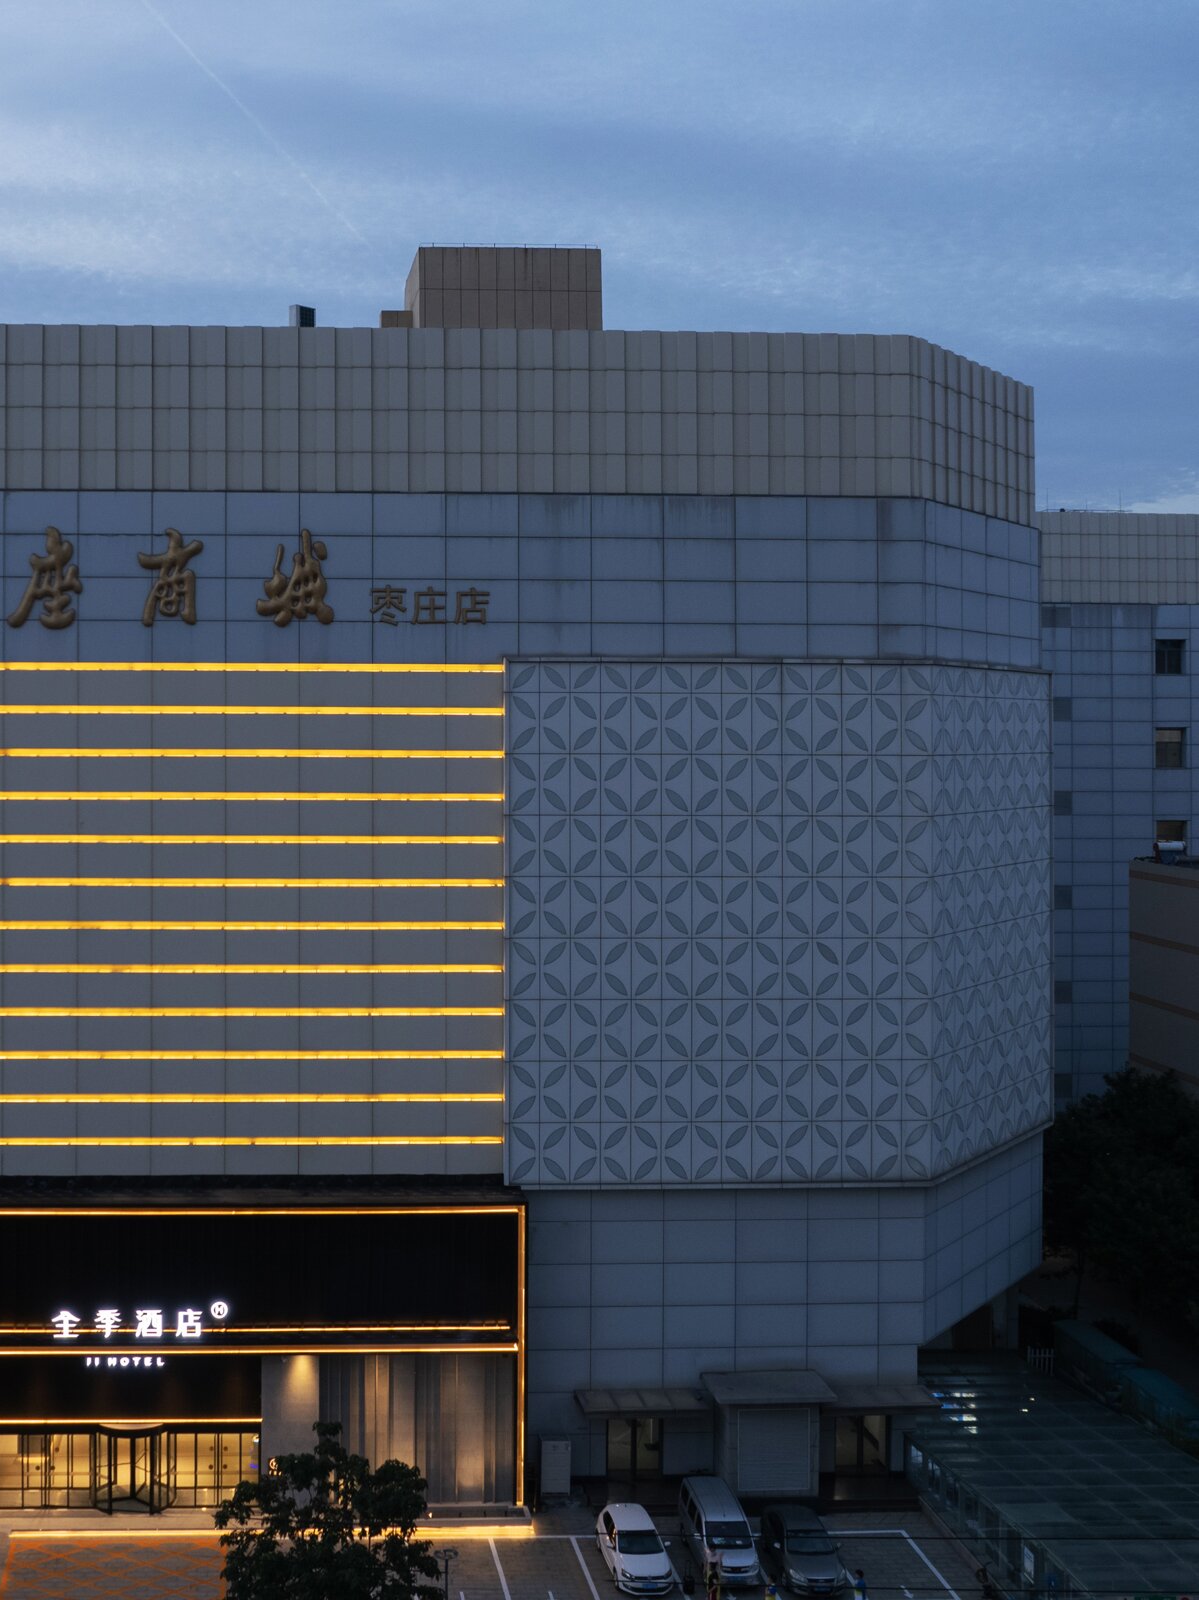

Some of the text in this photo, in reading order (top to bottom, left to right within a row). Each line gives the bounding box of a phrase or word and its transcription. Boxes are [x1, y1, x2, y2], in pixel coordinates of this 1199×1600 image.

[370, 584, 490, 626] 枣庄店
[51, 1308, 203, 1339] 全季酒店
[107, 1356, 165, 1367] HOTEL
